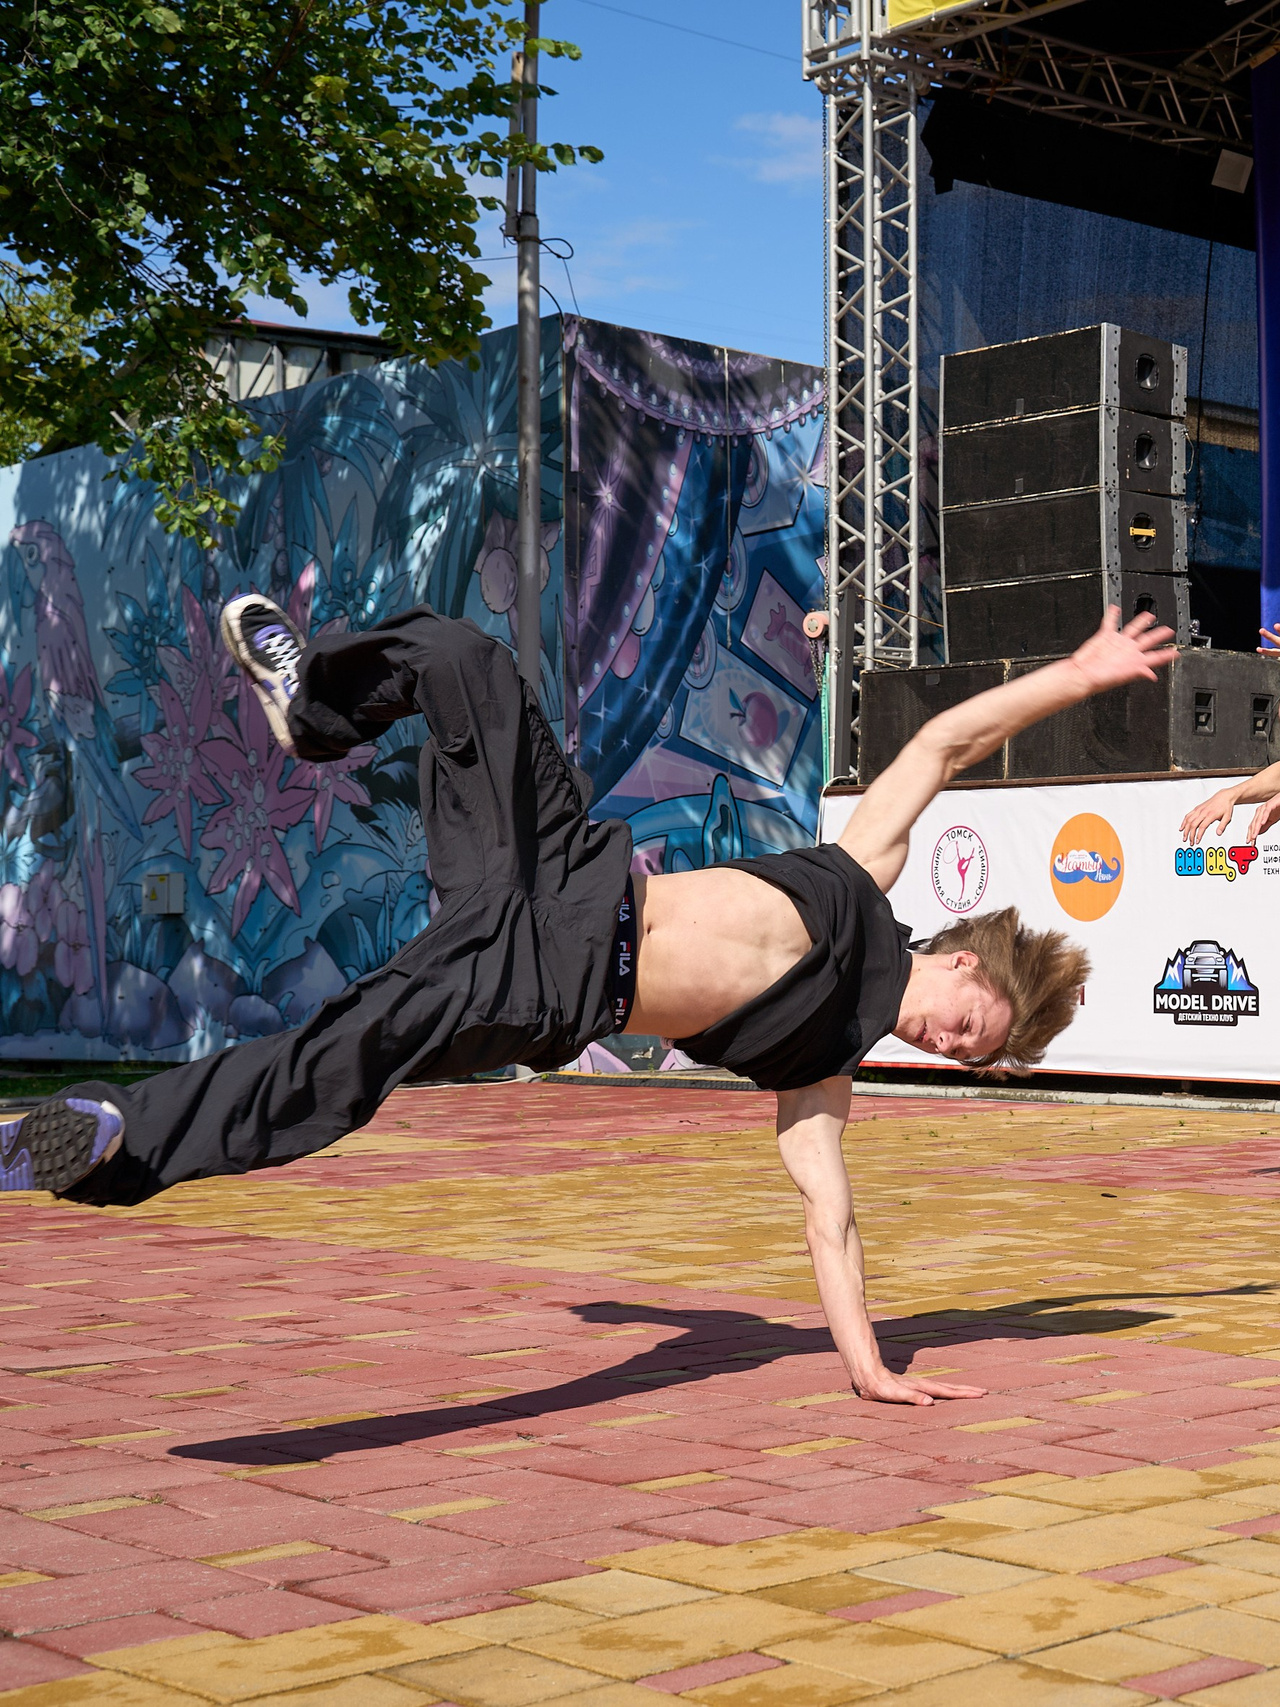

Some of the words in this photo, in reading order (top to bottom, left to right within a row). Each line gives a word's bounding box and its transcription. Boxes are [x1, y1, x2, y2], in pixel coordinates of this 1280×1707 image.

[946, 829, 974, 842] ТОМСК
[933, 846, 945, 898] ЦИРКОВАЯ
[618, 941, 631, 976] FILA
[1155, 993, 1209, 1011] MODEL
[1211, 994, 1257, 1012] DRIVE
[1178, 1011, 1202, 1022] ДЕТСКИЙ
[1202, 1013, 1219, 1022] ТЕХНО
[1219, 1014, 1234, 1023] КЛУБ
